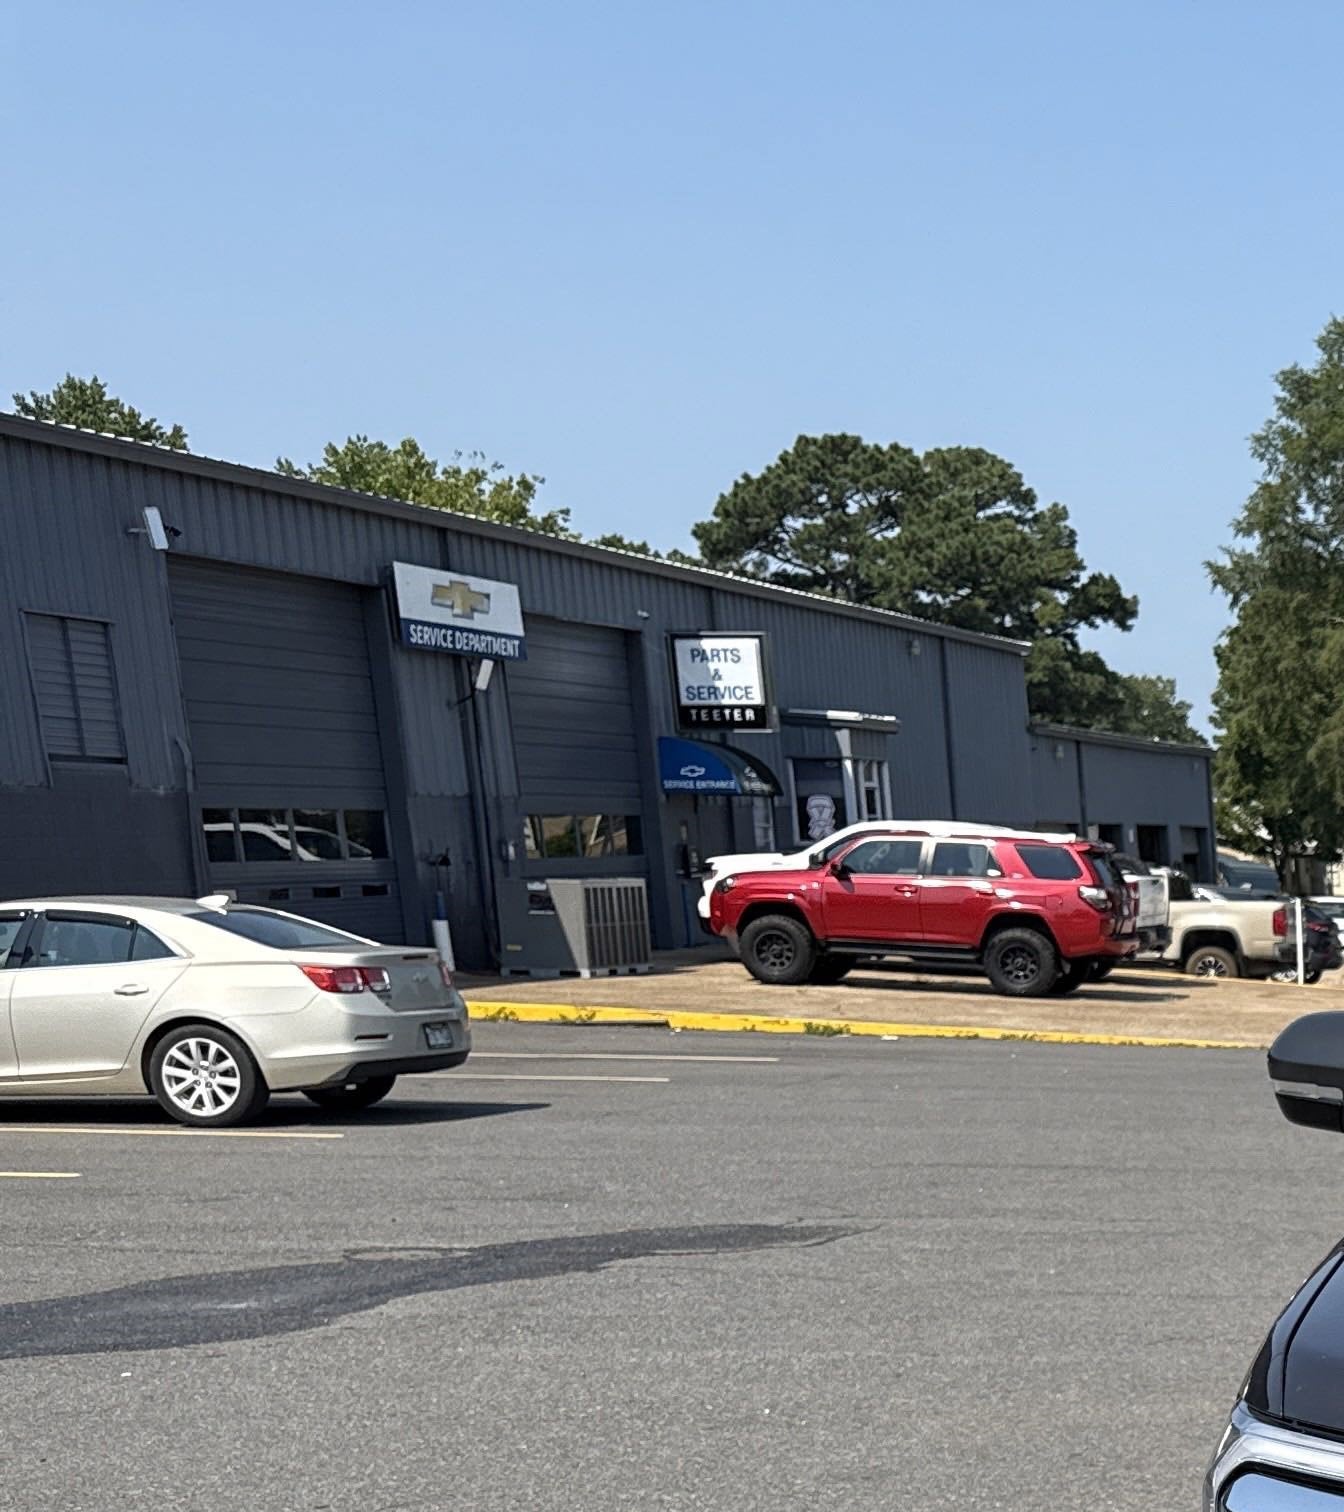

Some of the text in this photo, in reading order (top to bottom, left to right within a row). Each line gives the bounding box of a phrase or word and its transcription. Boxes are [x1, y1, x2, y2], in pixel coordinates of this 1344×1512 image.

[409, 624, 520, 658] SERVICE DEPARTMENT
[690, 647, 741, 664] PARTS
[711, 668, 722, 681] &
[685, 685, 755, 701] SERVICE
[690, 708, 756, 722] TEETER
